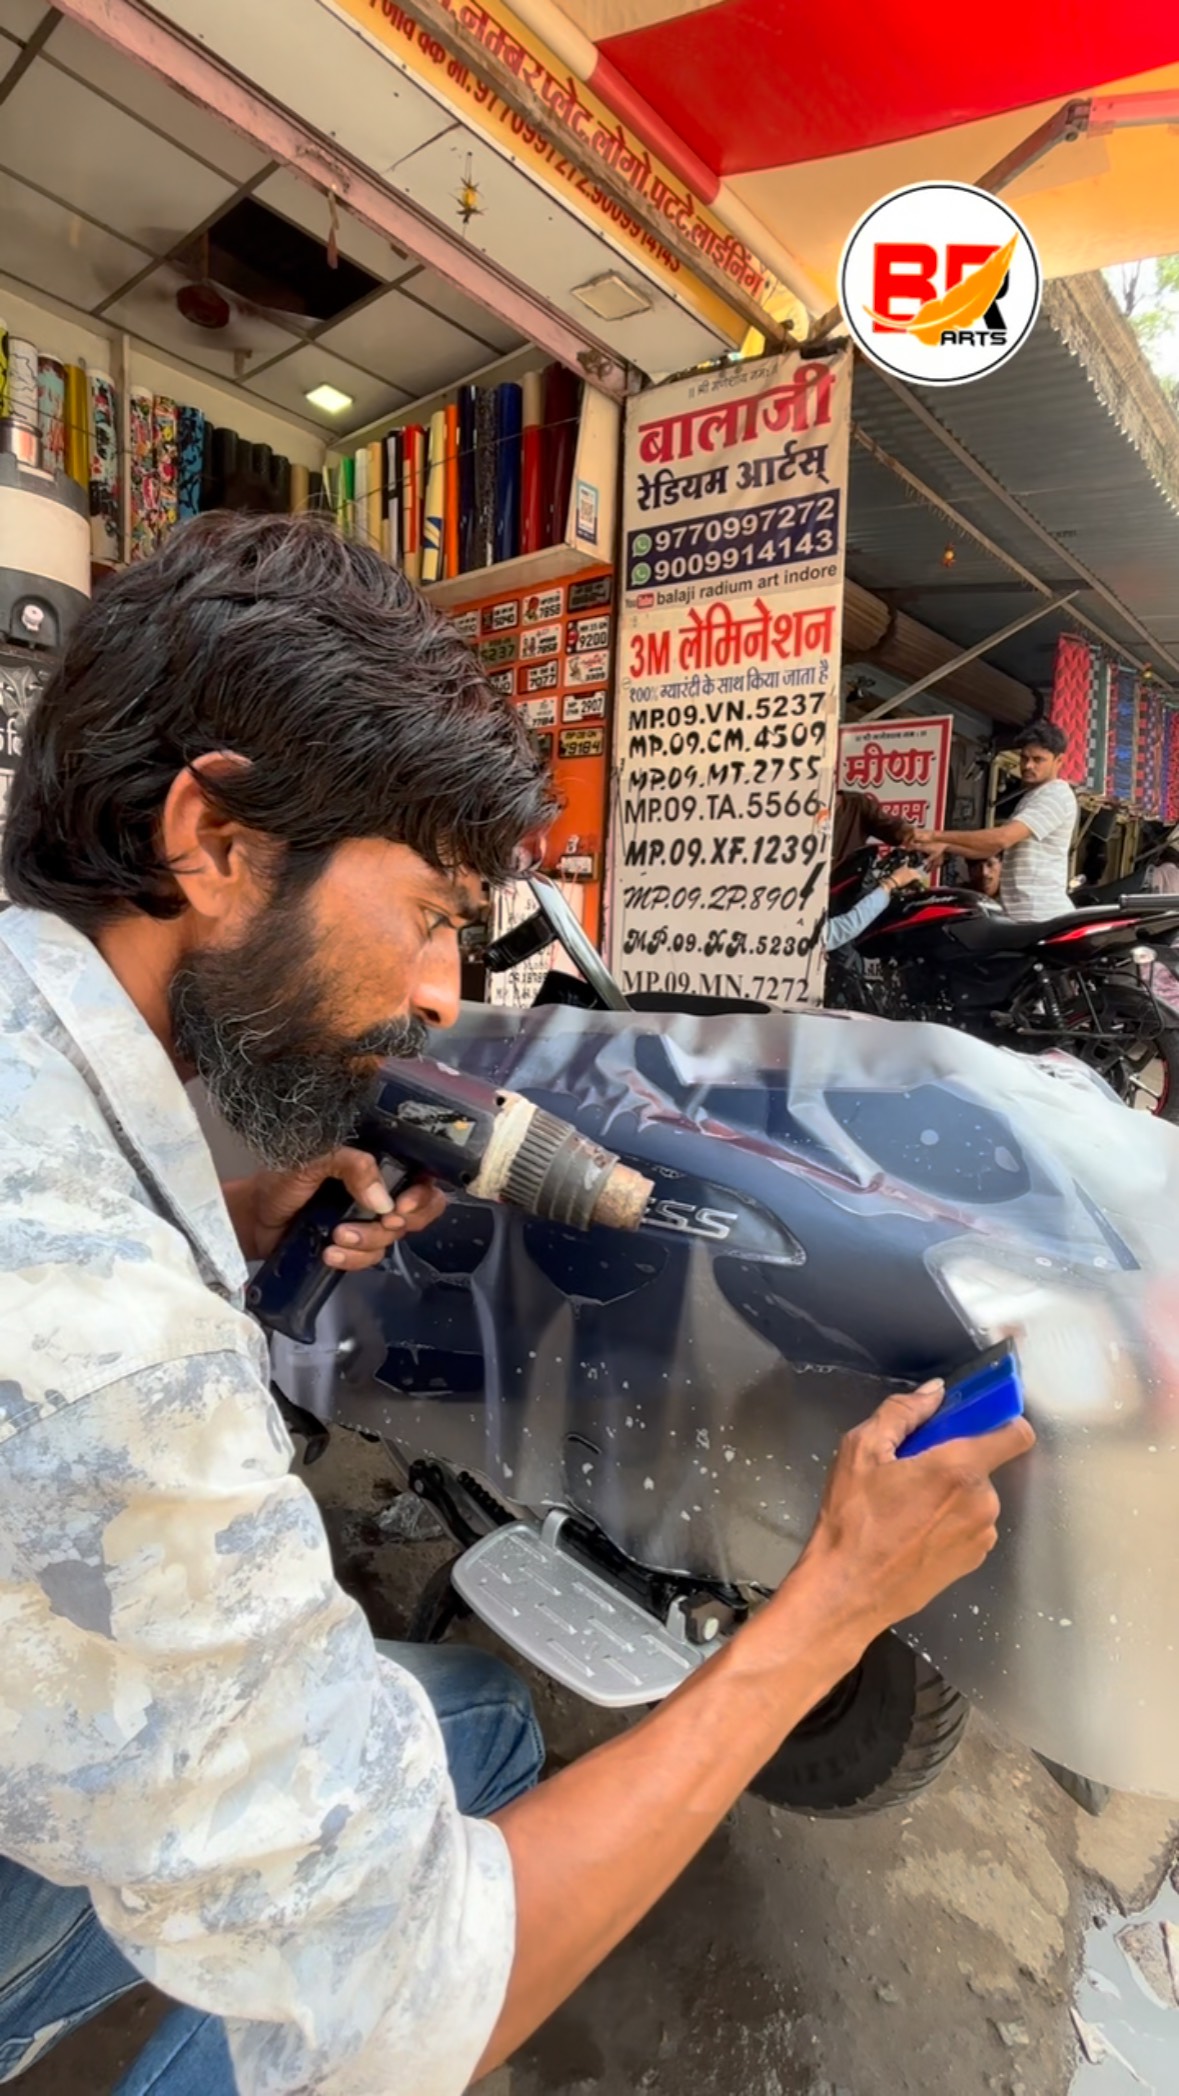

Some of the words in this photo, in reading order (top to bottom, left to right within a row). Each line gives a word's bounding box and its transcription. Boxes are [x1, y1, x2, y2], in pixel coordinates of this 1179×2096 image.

[637, 363, 836, 465] बालाजी
[637, 465, 729, 511] रेडियम
[736, 440, 830, 490] आर्टस्
[655, 497, 835, 552] 9770997272
[654, 529, 834, 581] 9009914143
[657, 586, 695, 605] balaji
[700, 576, 753, 598] radium
[757, 571, 779, 588] art
[783, 563, 837, 581] indore
[580, 631, 607, 649] 9200
[629, 630, 671, 679] 3M
[678, 597, 836, 671] लेमिनेशन
[717, 675, 744, 694] साथ
[746, 666, 780, 692] किया
[782, 667, 815, 687] जाता
[818, 659, 829, 686] है
[627, 692, 827, 732] MP.09.VN.5237
[628, 720, 826, 759] MP.09.CM.4509
[628, 756, 821, 794] MP.09.MT.2755
[844, 742, 935, 788] मीणा
[624, 789, 820, 824] MP.09.TA.5566
[624, 834, 818, 867] MP.09.XF.1239
[622, 970, 809, 1003] MP.09.MN.7272
